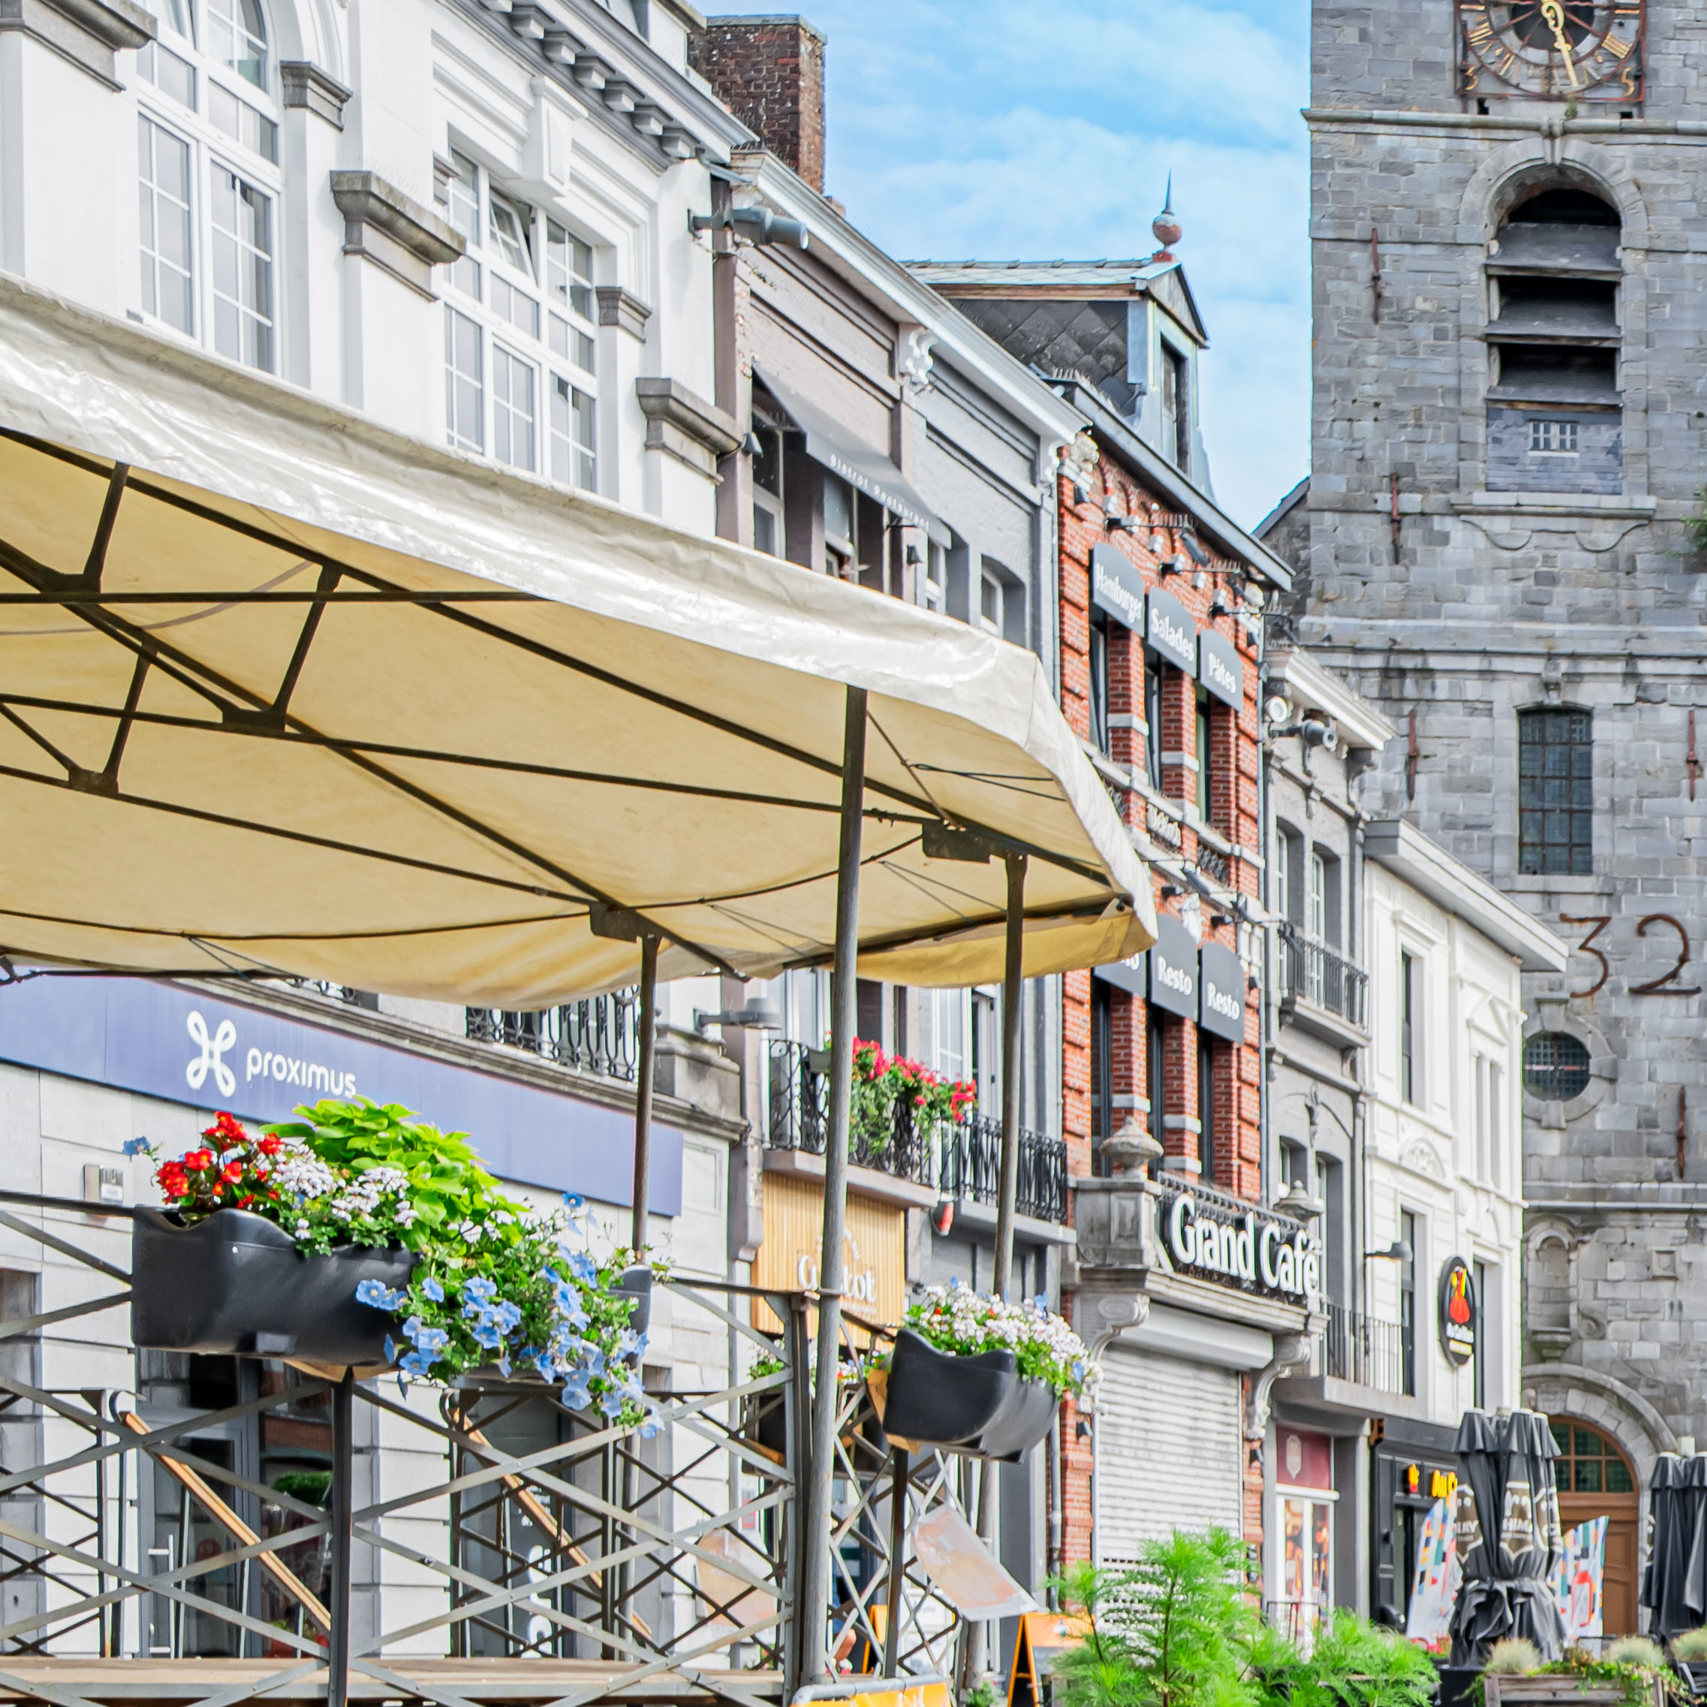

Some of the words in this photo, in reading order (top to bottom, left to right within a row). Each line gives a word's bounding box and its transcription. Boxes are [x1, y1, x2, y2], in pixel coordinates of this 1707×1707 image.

[1095, 561, 1143, 624] Hamburger
[1151, 607, 1195, 662] Salades
[1157, 955, 1193, 995] Resto
[1206, 981, 1240, 1020] Resto
[246, 1047, 357, 1099] proximus
[1171, 1192, 1257, 1281] Grand
[1259, 1220, 1319, 1302] Café
